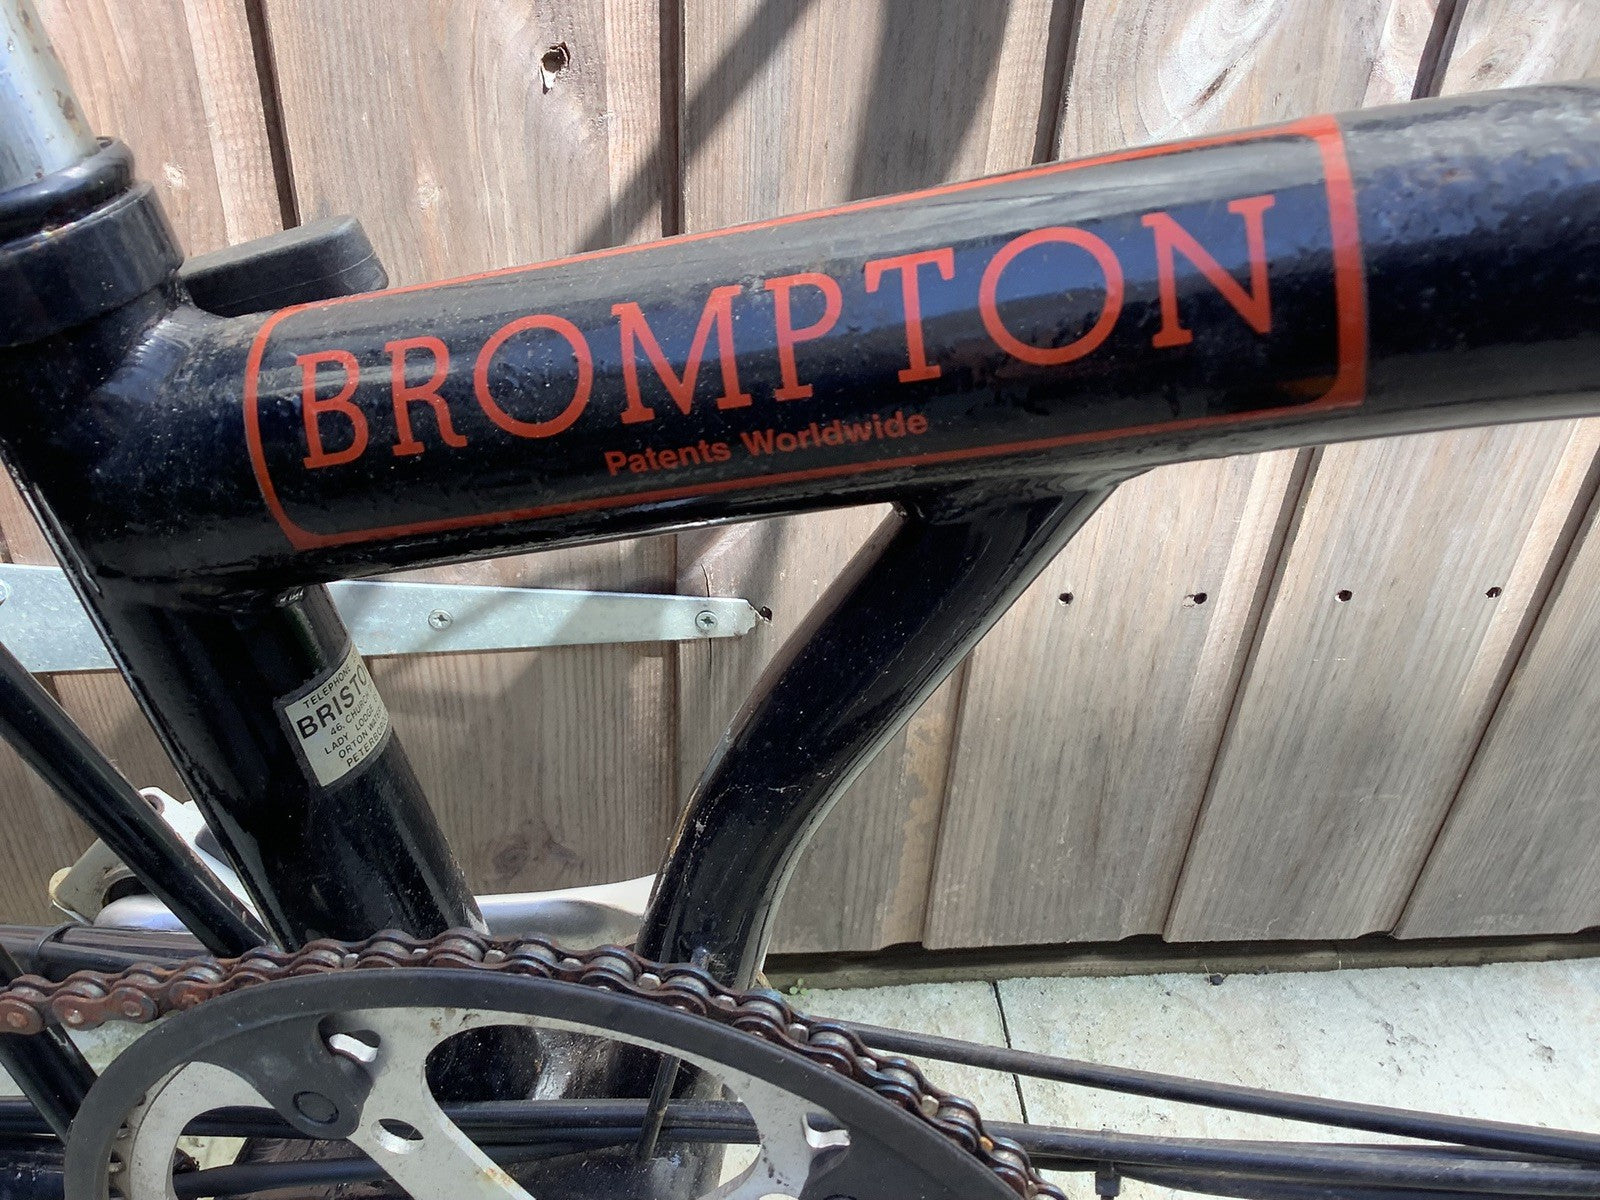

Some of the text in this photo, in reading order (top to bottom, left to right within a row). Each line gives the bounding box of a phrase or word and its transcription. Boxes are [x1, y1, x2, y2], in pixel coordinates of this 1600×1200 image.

[295, 193, 1277, 472] BROMPTON
[604, 410, 928, 477] Patents Worldwide
[296, 664, 369, 740] BRISTO
[303, 665, 351, 709] TELEPHONE
[324, 703, 375, 755] LADY LODGE
[338, 729, 369, 759] ORTON
